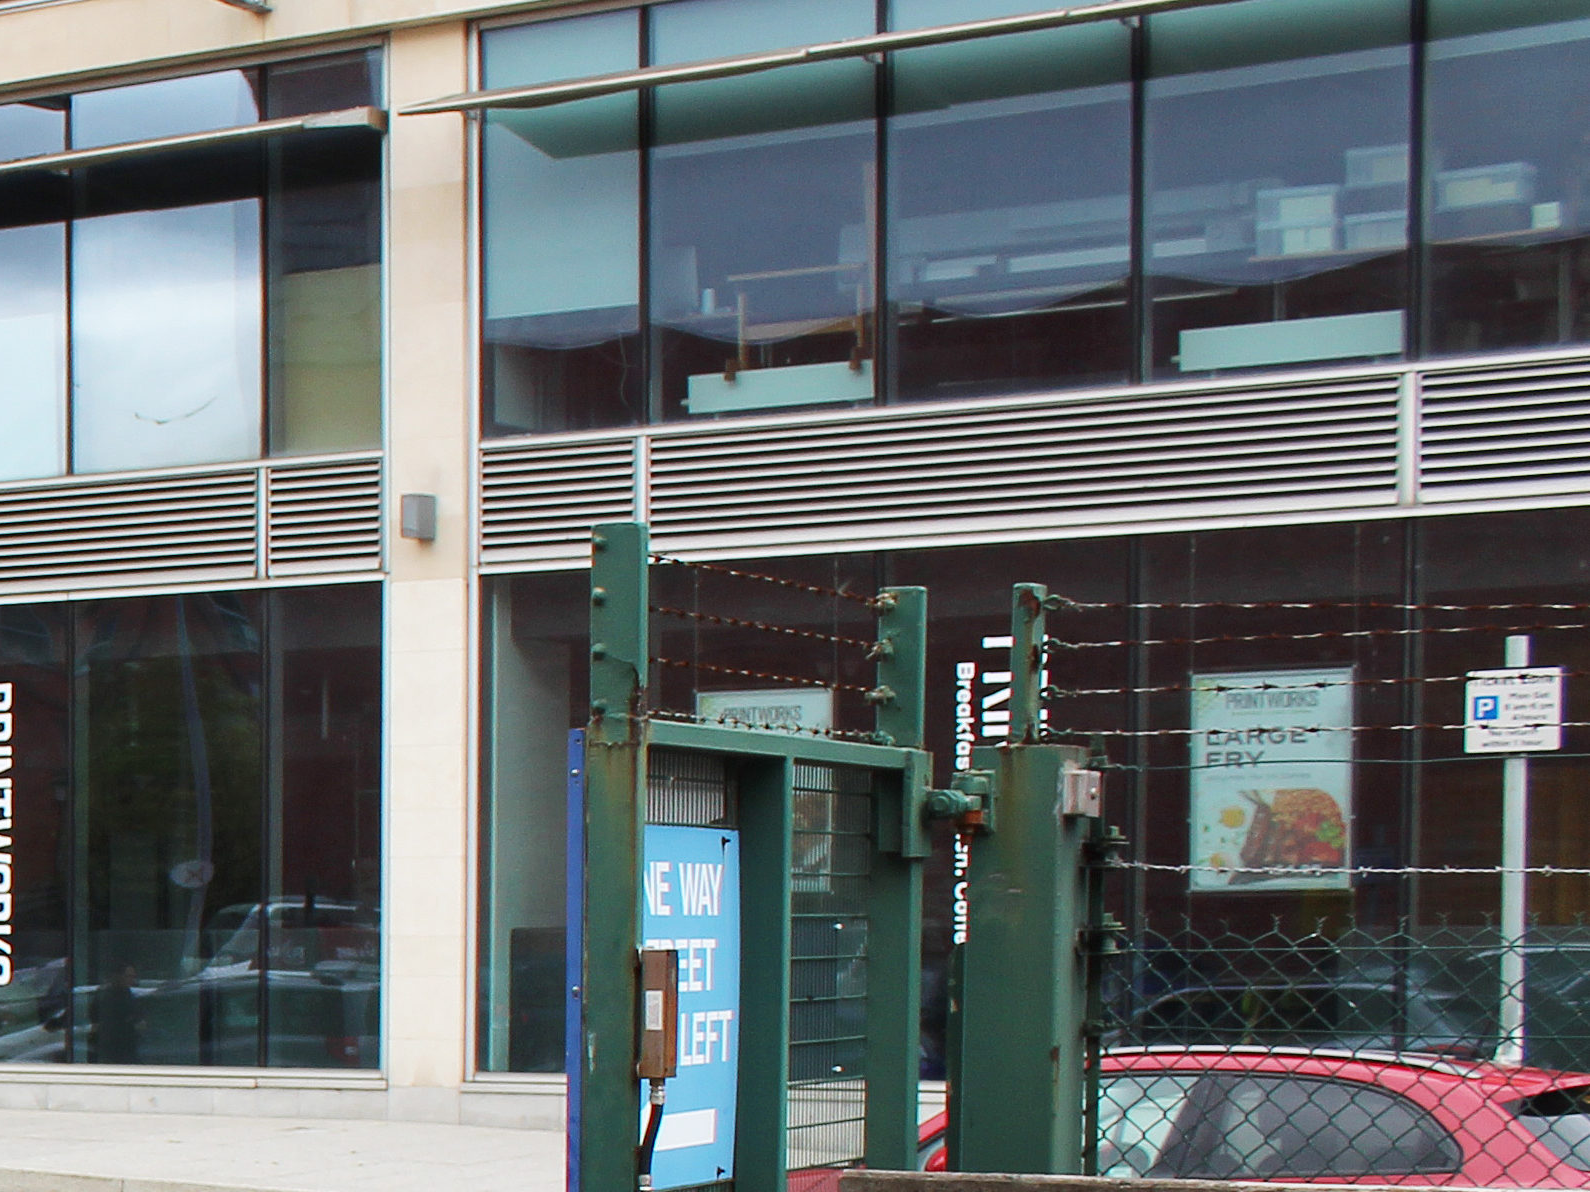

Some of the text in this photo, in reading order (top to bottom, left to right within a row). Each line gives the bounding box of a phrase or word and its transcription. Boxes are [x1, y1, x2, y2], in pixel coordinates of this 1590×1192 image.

[956, 662, 975, 770] Breakfas
[1206, 727, 1307, 746] LARGE
[1206, 750, 1264, 768] FRY
[643, 861, 723, 917] NE WAY
[680, 1010, 734, 1067] LEFT
